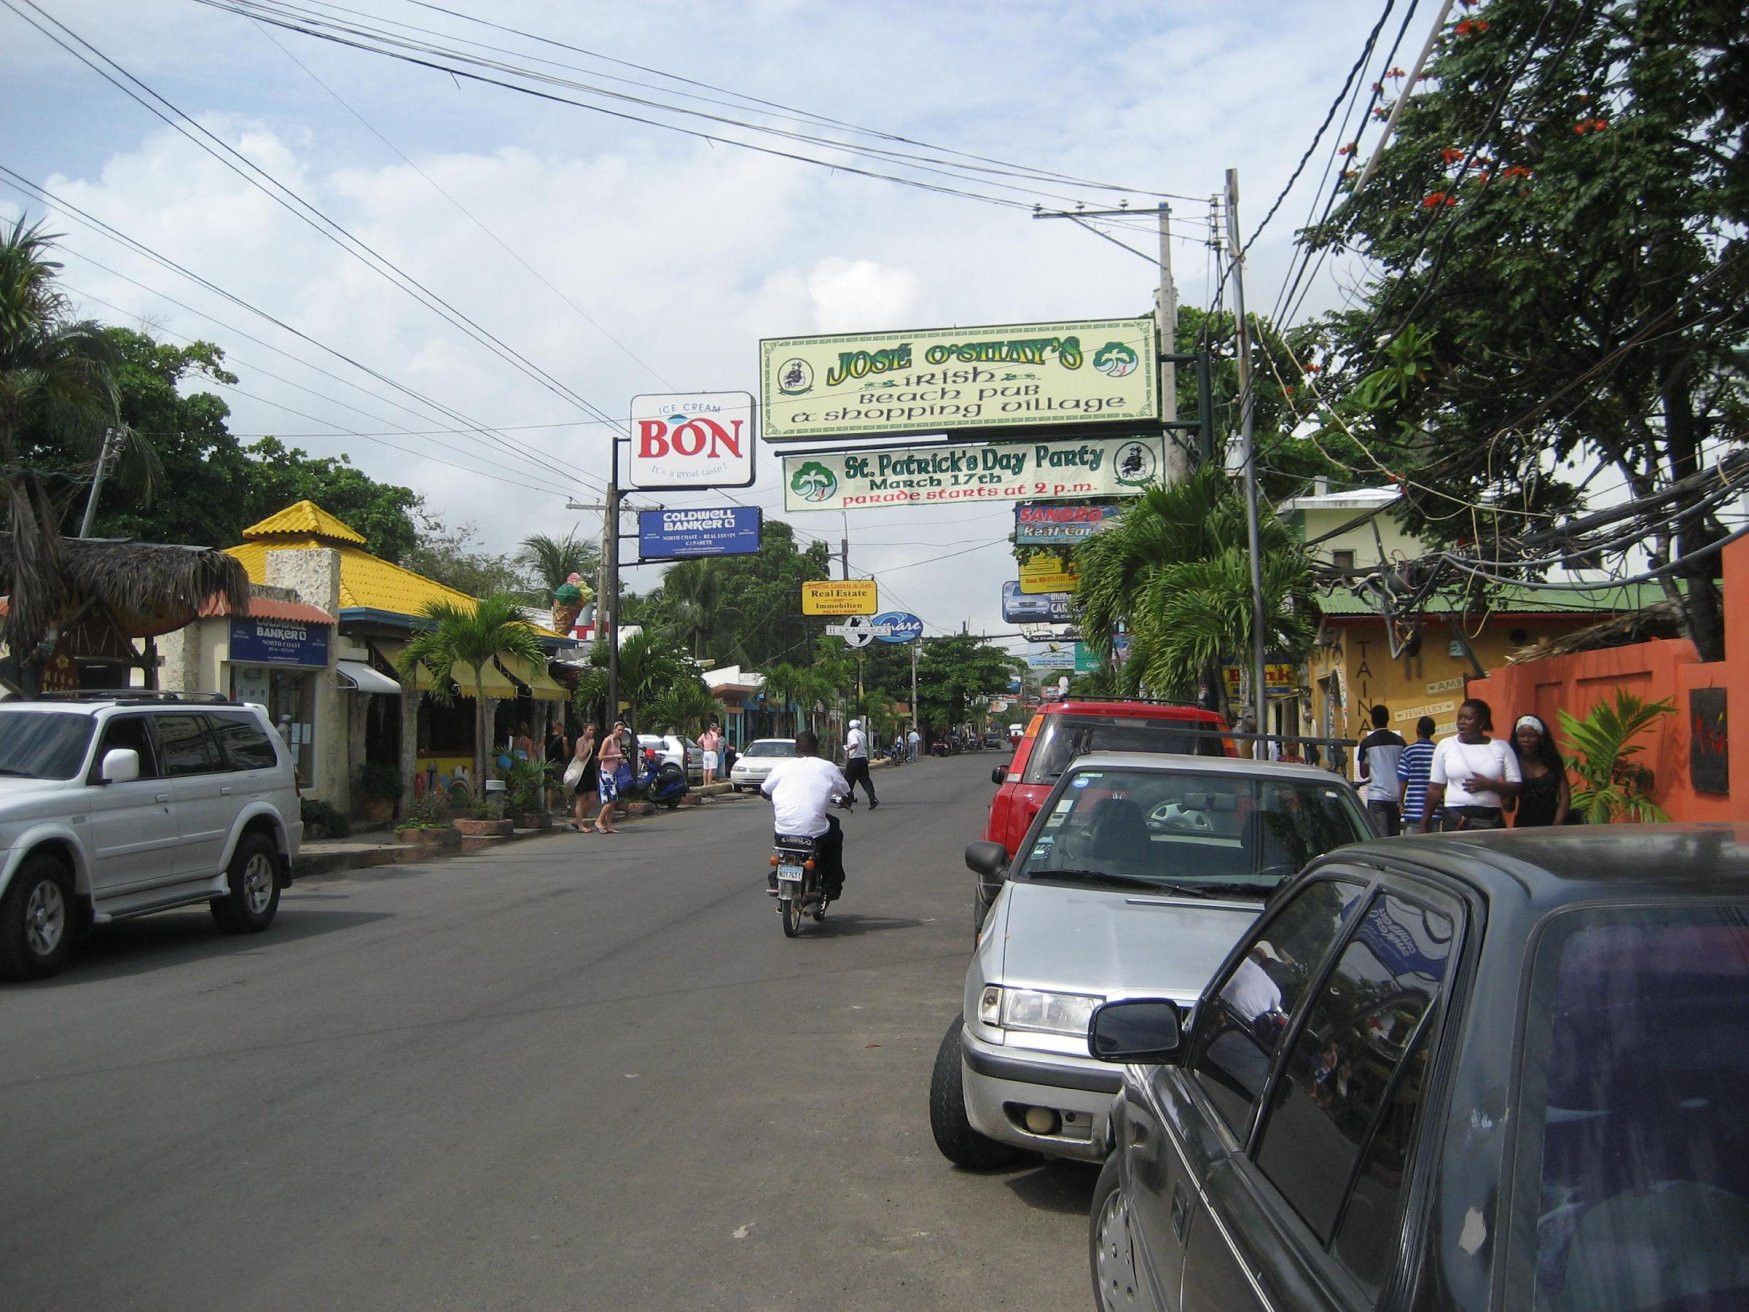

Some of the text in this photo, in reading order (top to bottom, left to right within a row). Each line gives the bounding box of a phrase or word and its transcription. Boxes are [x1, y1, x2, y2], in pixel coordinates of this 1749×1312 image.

[925, 335, 1084, 371] O'SHAY'S
[658, 402, 721, 415] ICE CREAM
[824, 402, 983, 422] shopping
[1001, 396, 1126, 413] village
[638, 418, 744, 459] BON
[844, 444, 1105, 480] St. Patrick's Day Party
[651, 465, 666, 475] It's
[676, 470, 699, 478] great
[869, 472, 1002, 491] March 17th
[842, 481, 1098, 508] parade starts at 2 p.m.
[662, 509, 736, 522] COLDWELL
[663, 519, 723, 532] BANKER
[811, 589, 868, 598] Real Estate
[256, 626, 299, 641] BANKER
